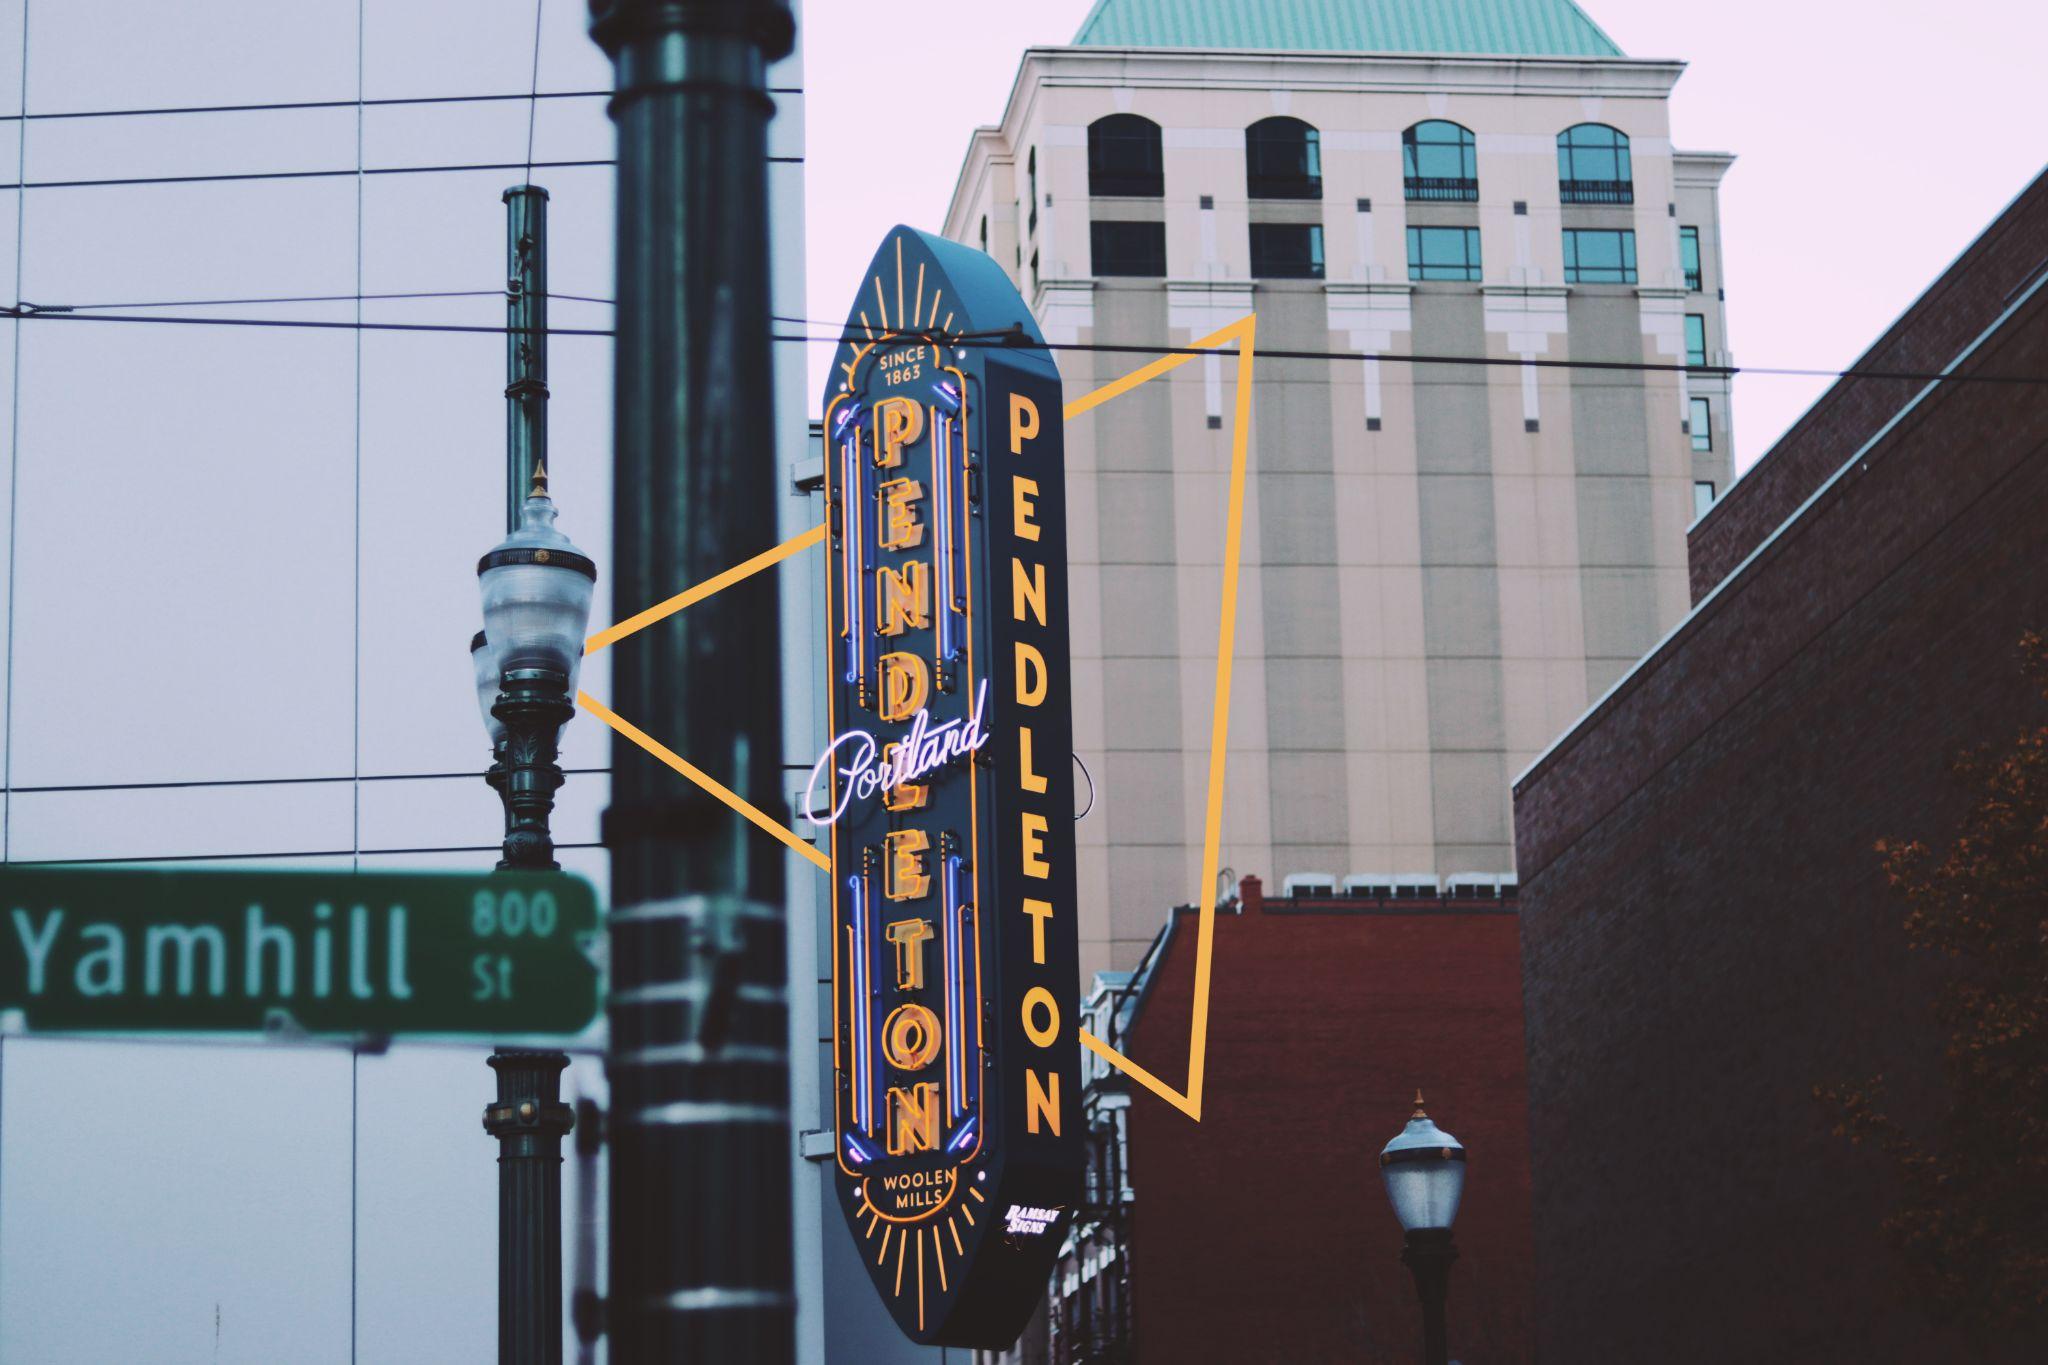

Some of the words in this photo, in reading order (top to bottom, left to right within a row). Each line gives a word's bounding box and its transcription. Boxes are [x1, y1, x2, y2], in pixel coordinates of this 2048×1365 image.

[879, 346, 926, 370] SINCE
[884, 364, 921, 386] 1863
[805, 677, 990, 826] Portland
[1009, 392, 1061, 1137] PENDLETON
[472, 889, 557, 936] 800
[11, 904, 412, 997] Yamhill
[472, 953, 514, 1000] St
[883, 1169, 955, 1191] WOOLEN
[896, 1189, 944, 1209] MILLS
[1005, 1205, 1060, 1222] RAMSAY
[1007, 1217, 1047, 1235] SIGNS
